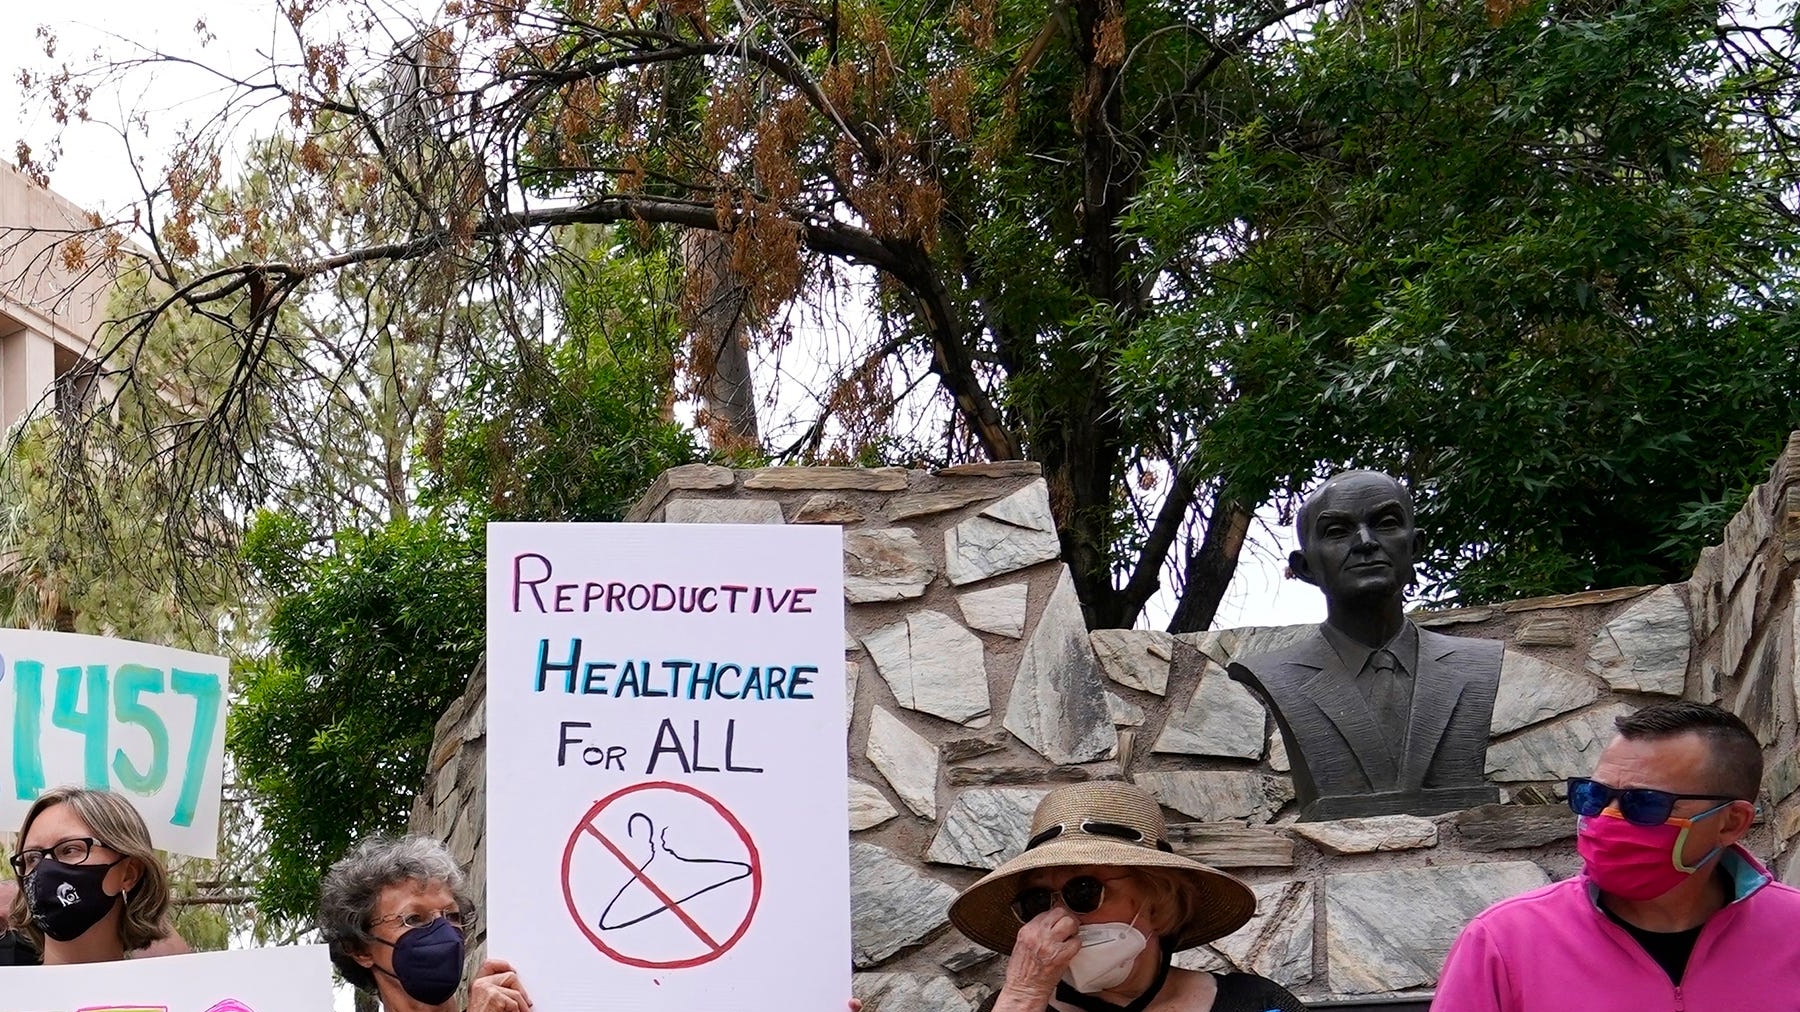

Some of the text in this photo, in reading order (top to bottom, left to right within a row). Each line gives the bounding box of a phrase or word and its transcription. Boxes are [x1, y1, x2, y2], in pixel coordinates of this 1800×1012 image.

[512, 553, 818, 615] REPRODUCTIVE
[534, 638, 819, 701] HEALTHCARE
[11, 659, 222, 827] 1457
[645, 718, 764, 775] ALL
